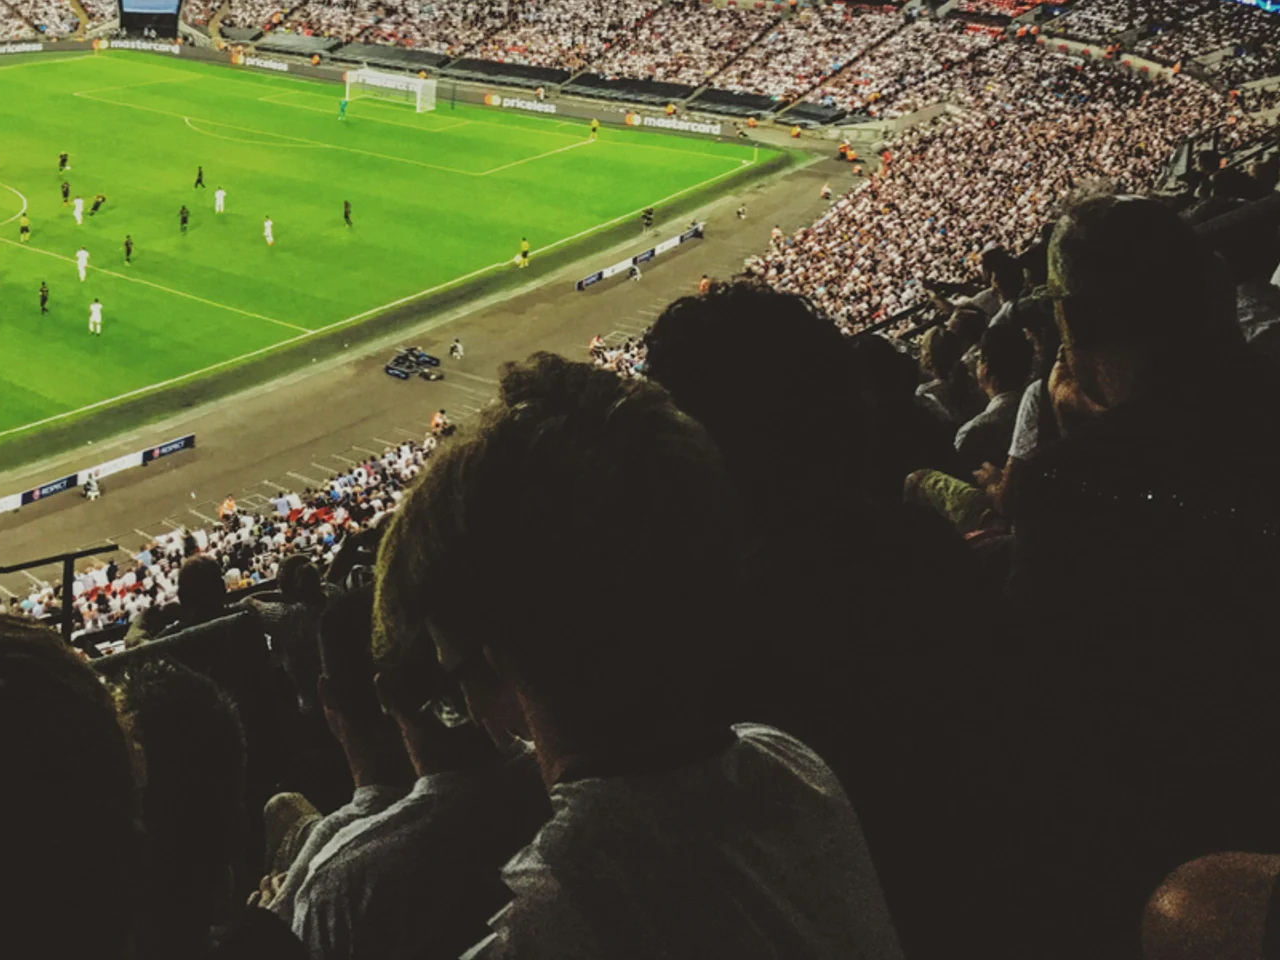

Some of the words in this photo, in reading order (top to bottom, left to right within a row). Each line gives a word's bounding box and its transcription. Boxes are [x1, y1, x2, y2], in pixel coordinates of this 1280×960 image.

[110, 40, 180, 54] mastercard
[246, 57, 288, 71] priceless
[502, 97, 556, 113] priceless
[643, 116, 721, 135] mastercard
[41, 480, 68, 495] RESPECT
